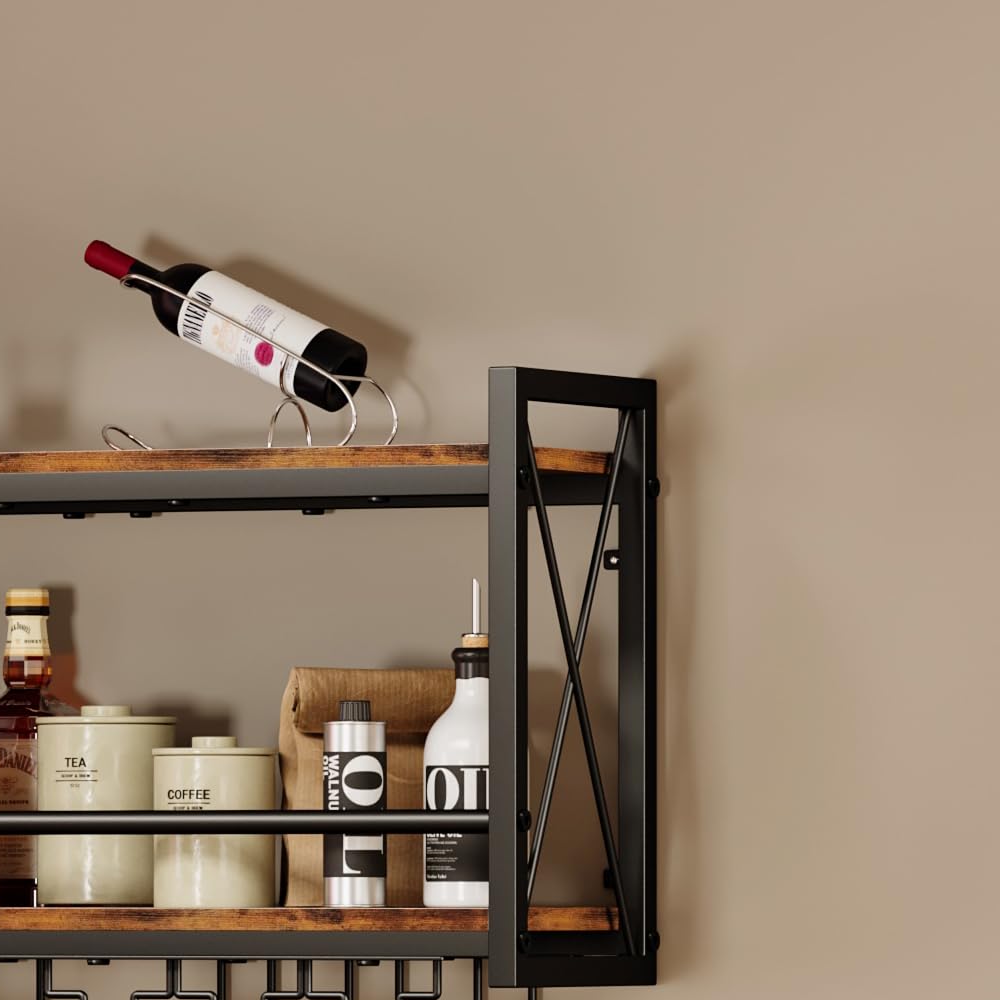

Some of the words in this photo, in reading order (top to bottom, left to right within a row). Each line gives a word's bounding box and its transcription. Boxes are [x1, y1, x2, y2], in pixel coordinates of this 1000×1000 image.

[64, 757, 87, 768] TEA
[328, 754, 340, 811] WALNU
[167, 789, 211, 800] COFFEE
[427, 767, 489, 810] OI
[342, 754, 384, 875] OL
